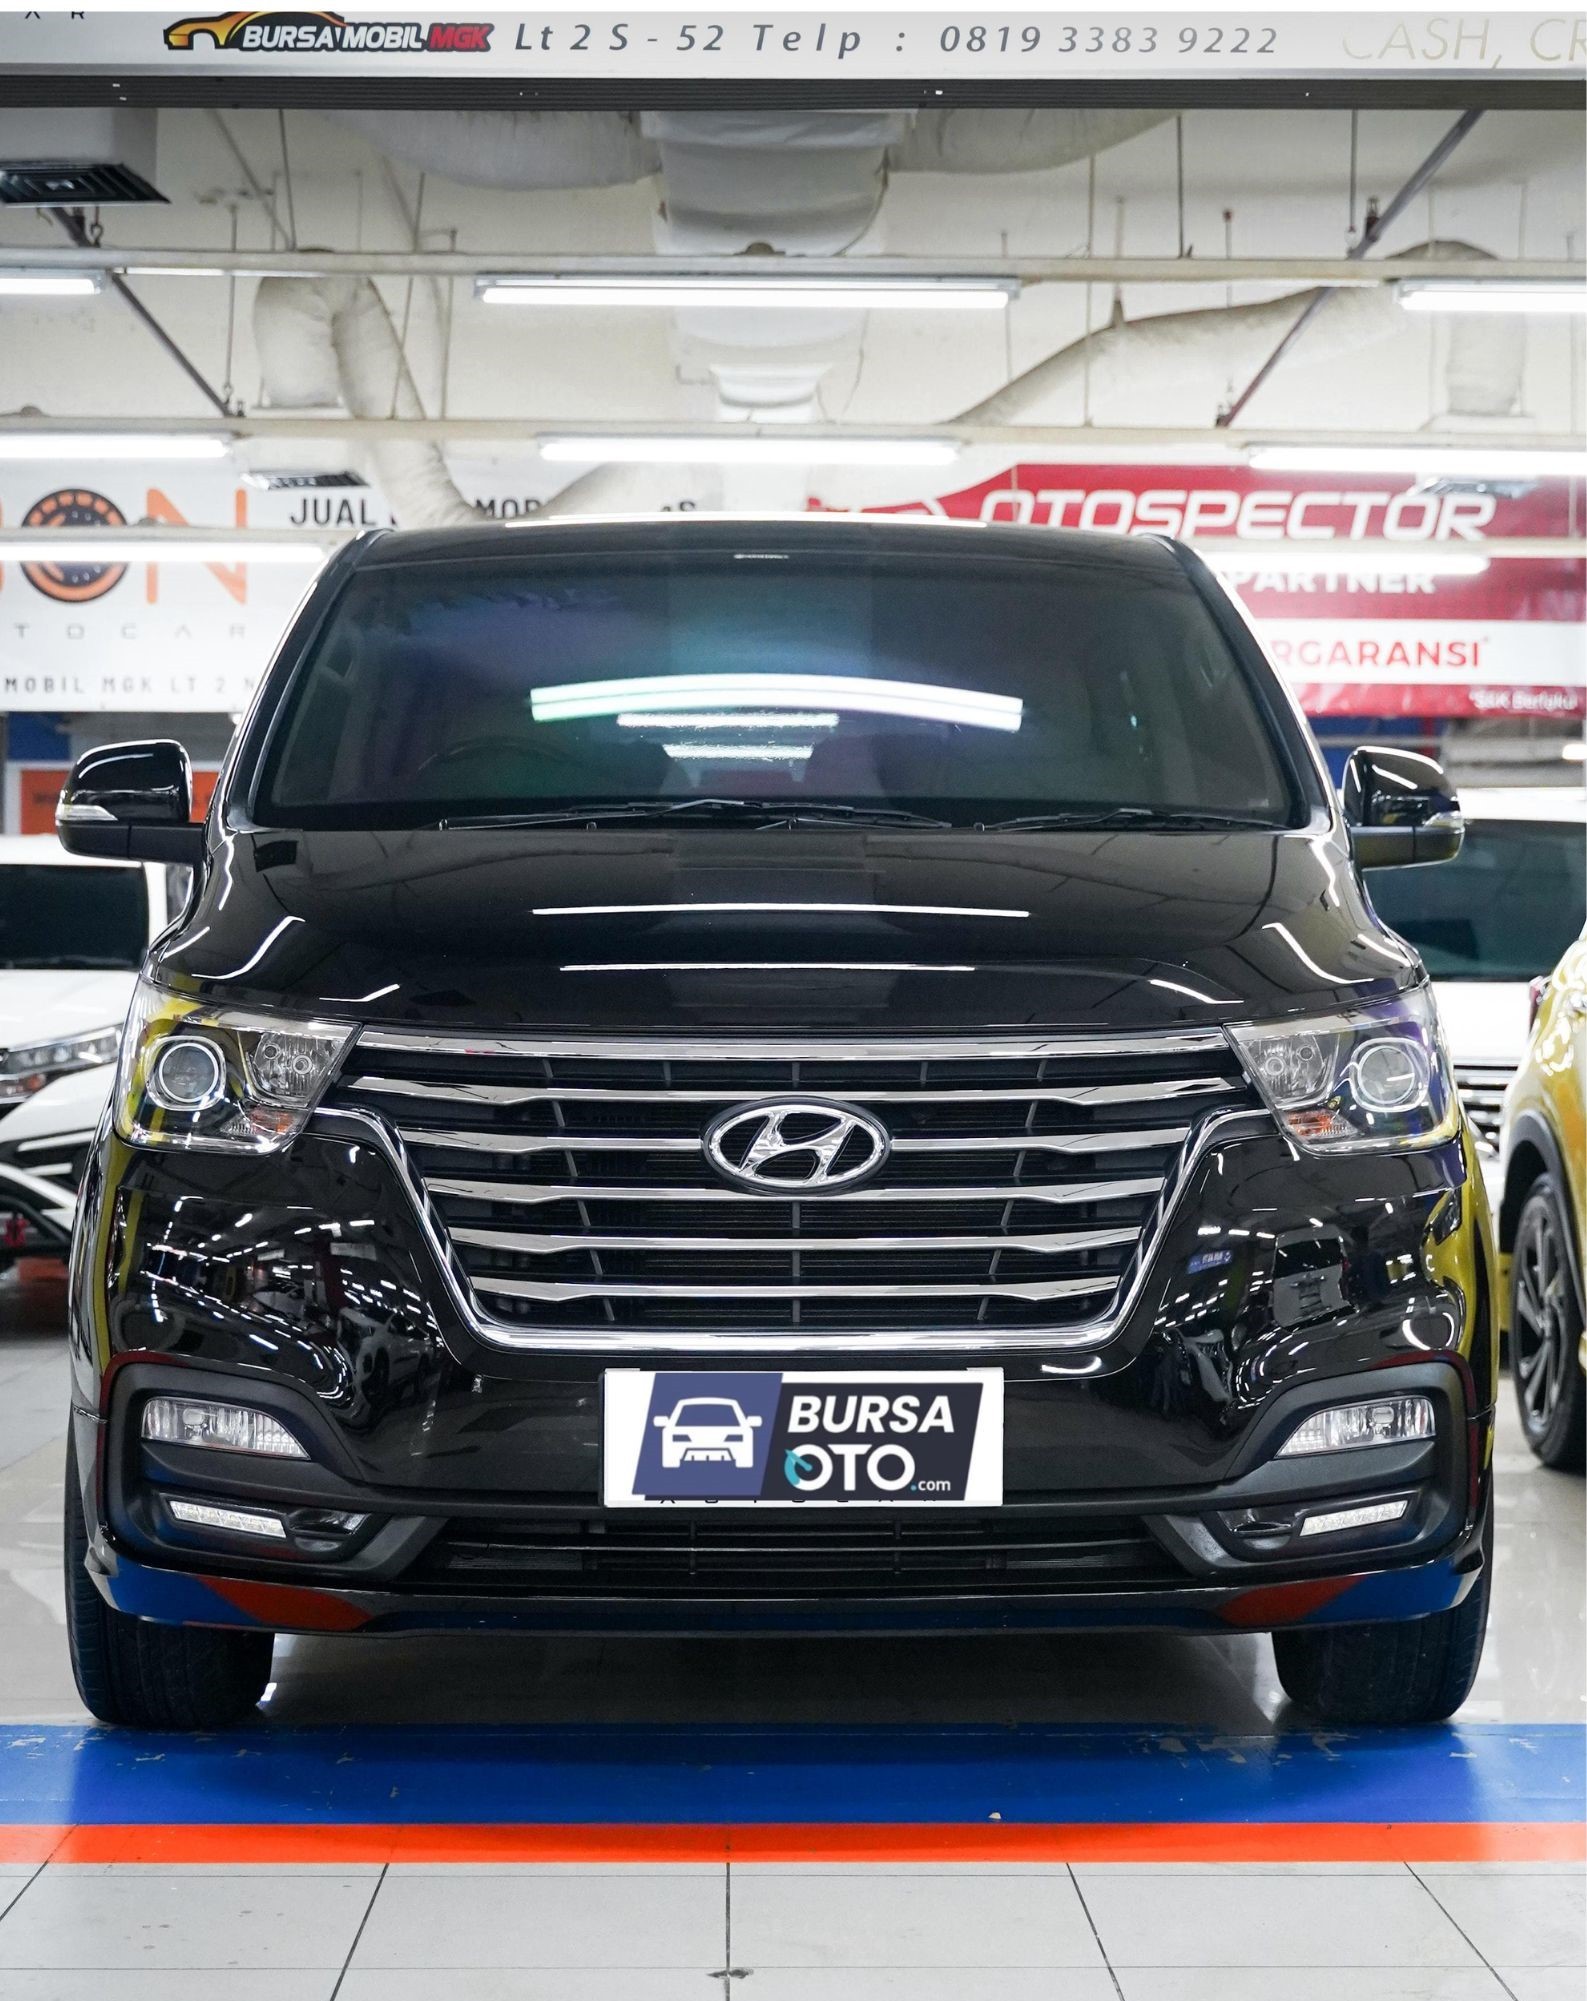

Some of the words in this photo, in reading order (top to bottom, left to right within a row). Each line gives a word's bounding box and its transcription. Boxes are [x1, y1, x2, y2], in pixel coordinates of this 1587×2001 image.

[243, 26, 334, 48] BURSA
[343, 26, 422, 48] MOBIL
[429, 26, 490, 48] MGK
[515, 23, 553, 50] Lt
[569, 24, 591, 50] 2
[609, 23, 629, 50] S
[676, 24, 725, 50] 52
[753, 24, 861, 59] Telp
[940, 26, 1041, 52] 0819
[1058, 27, 1158, 53] 3383
[1178, 27, 1277, 53] 9222
[290, 498, 376, 525] JUAL
[981, 489, 1497, 541] OTOSPECTOR
[1226, 572, 1437, 594] PARTNER
[5, 678, 85, 694] MOBIL
[101, 678, 152, 694] MGK
[171, 677, 197, 694] LT
